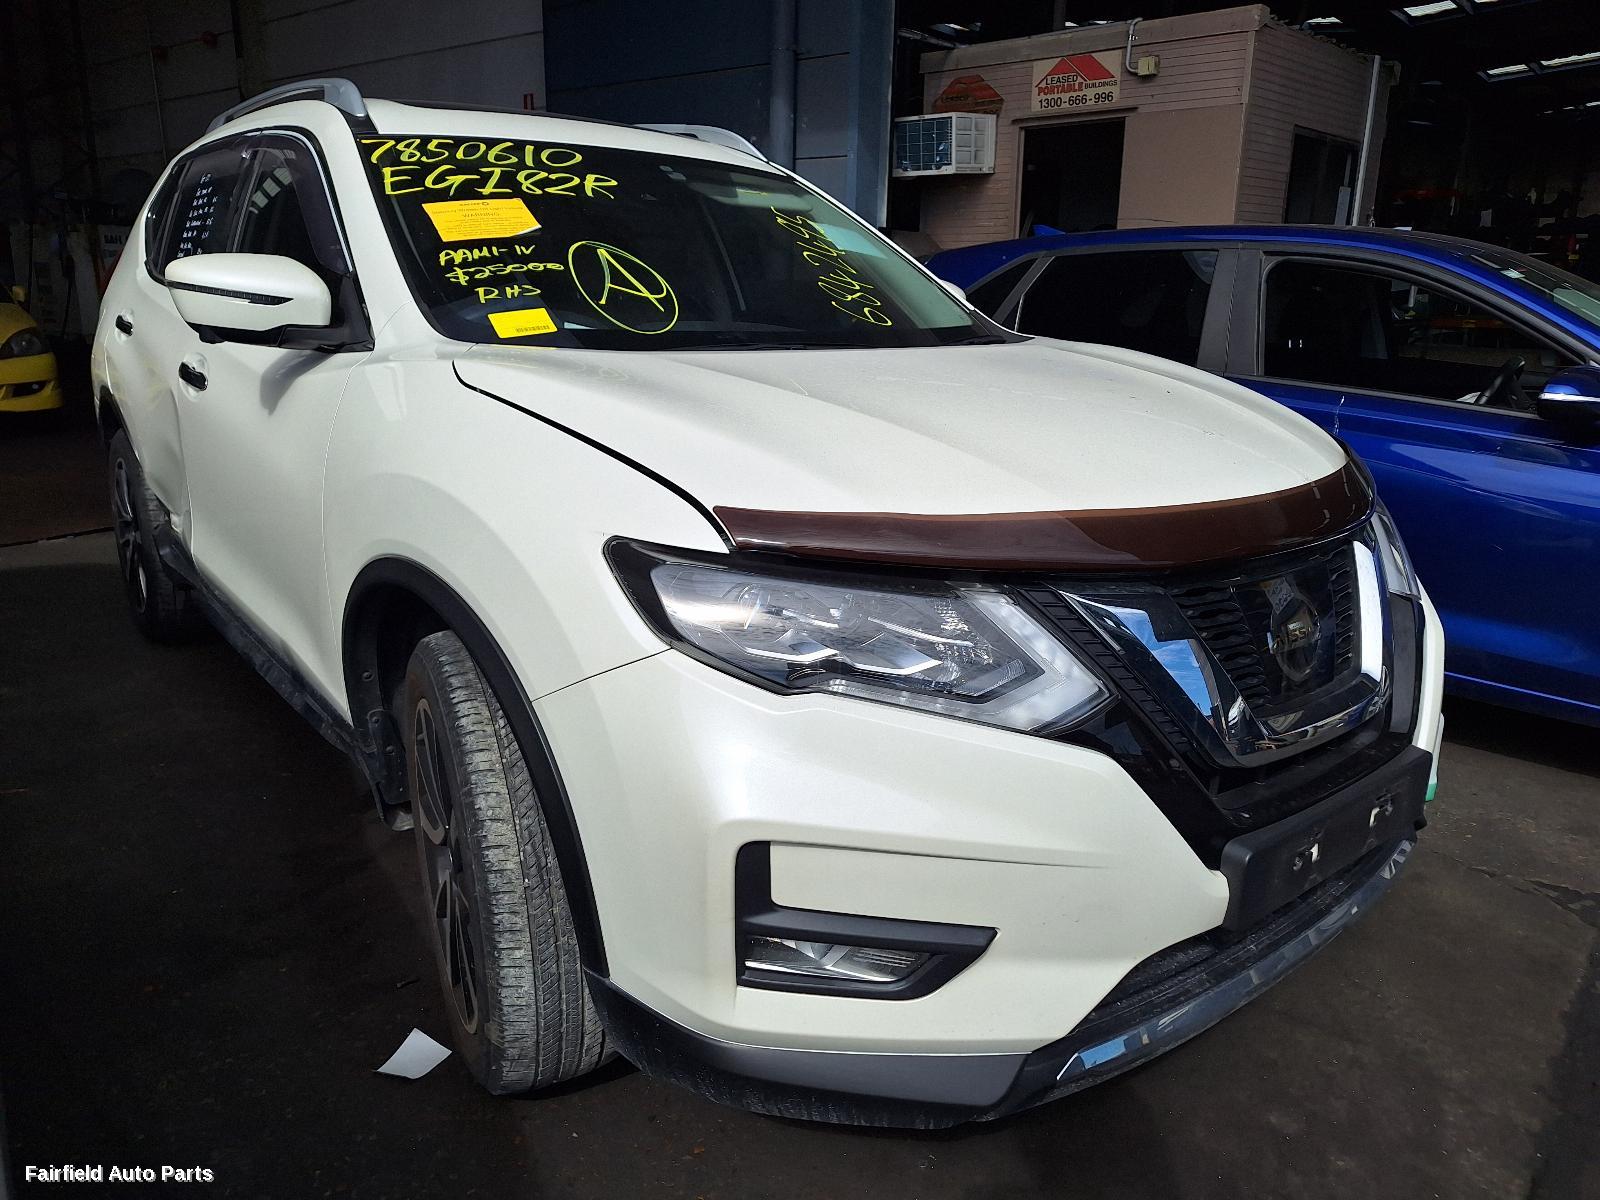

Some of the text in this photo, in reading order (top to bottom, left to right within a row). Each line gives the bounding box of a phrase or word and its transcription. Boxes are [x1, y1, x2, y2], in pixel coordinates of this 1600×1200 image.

[1038, 80, 1118, 96] PORTABLE BUILDINGS
[1045, 75, 1078, 86] LEASED
[1039, 91, 1114, 109] 1300-666-996
[361, 138, 582, 167] 7850610
